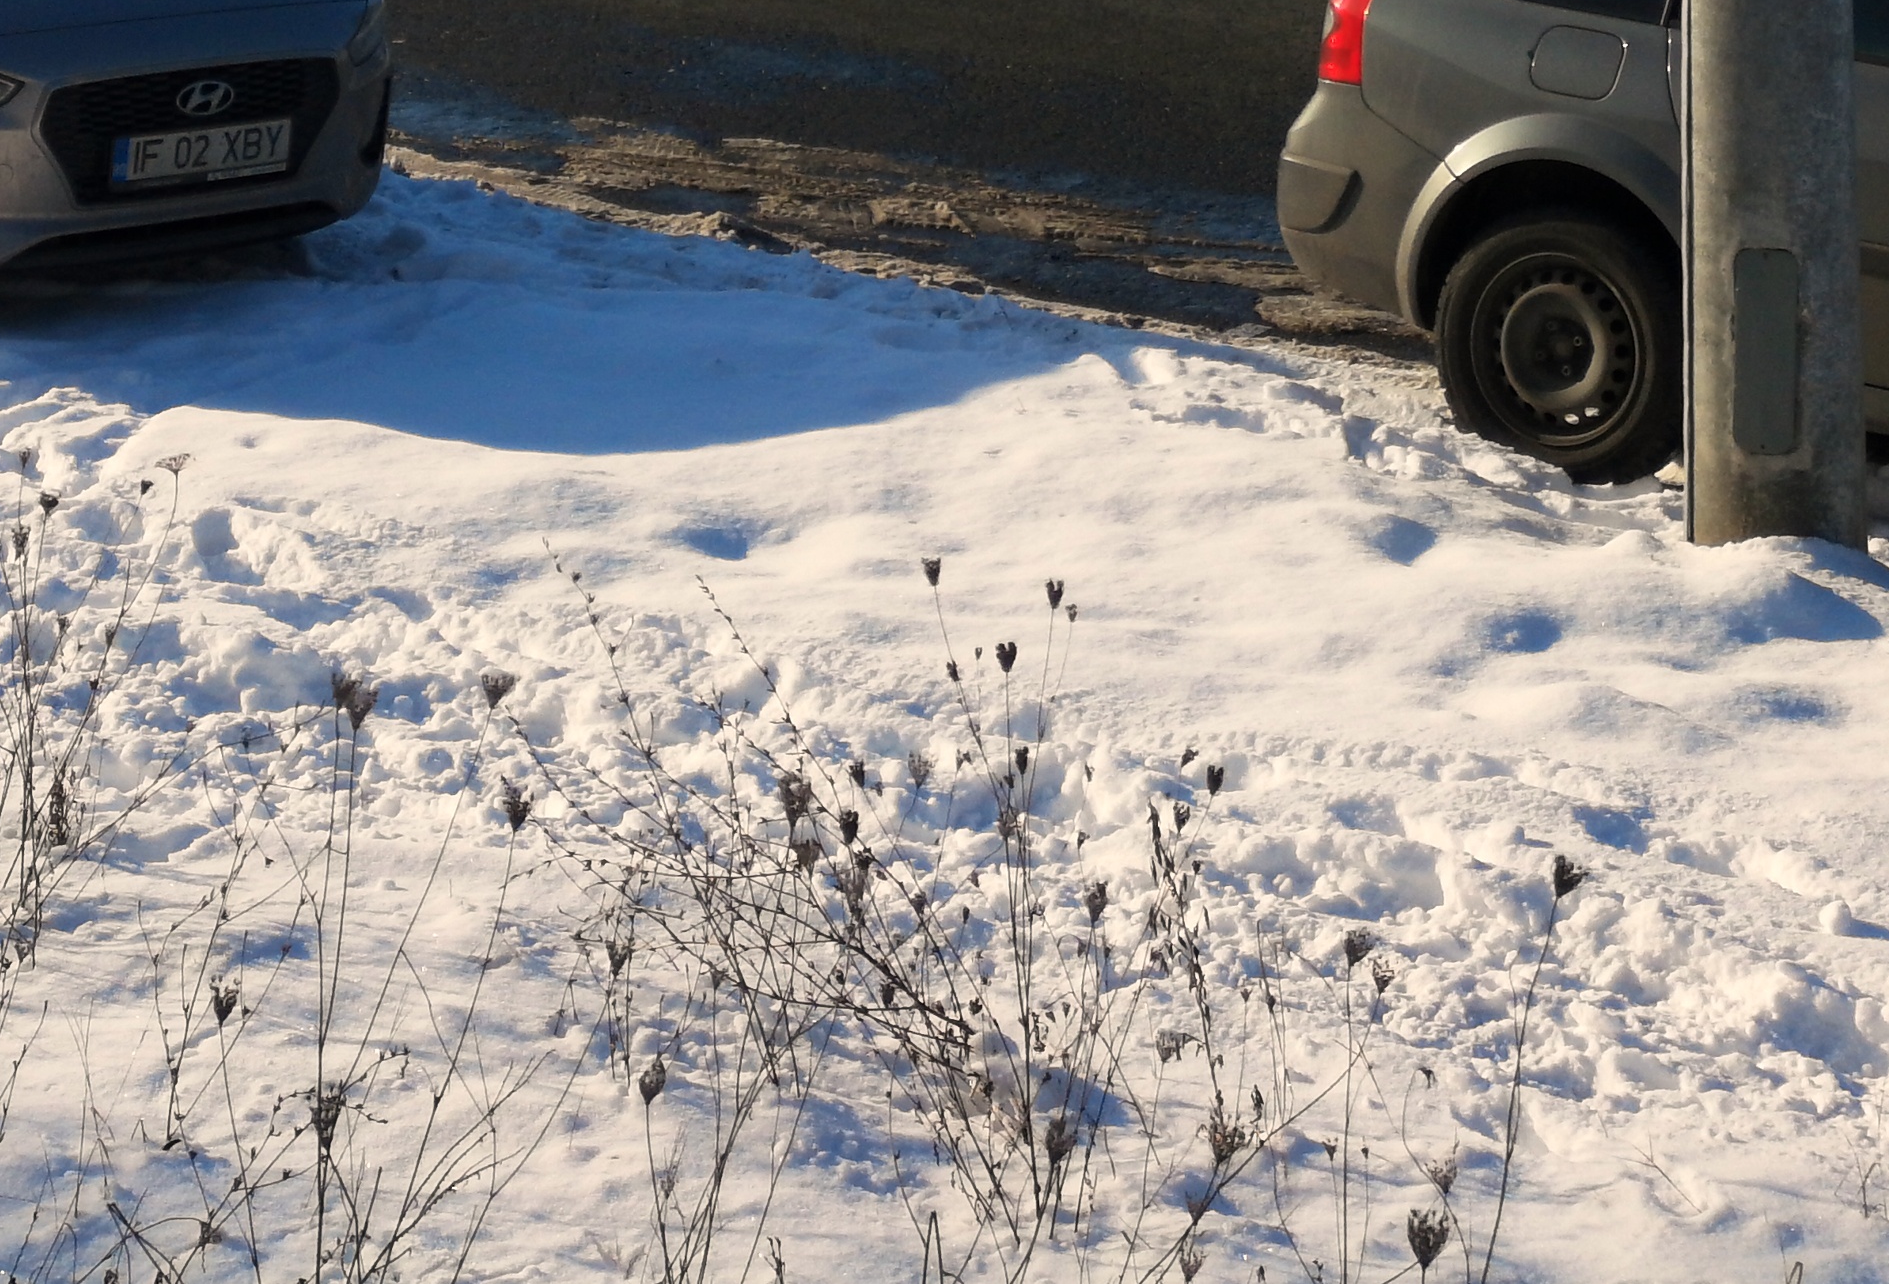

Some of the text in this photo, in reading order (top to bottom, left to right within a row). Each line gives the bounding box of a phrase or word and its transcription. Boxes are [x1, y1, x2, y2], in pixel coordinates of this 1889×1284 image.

[132, 138, 164, 174] IF
[174, 134, 210, 169] 02
[222, 124, 284, 164] XBY
